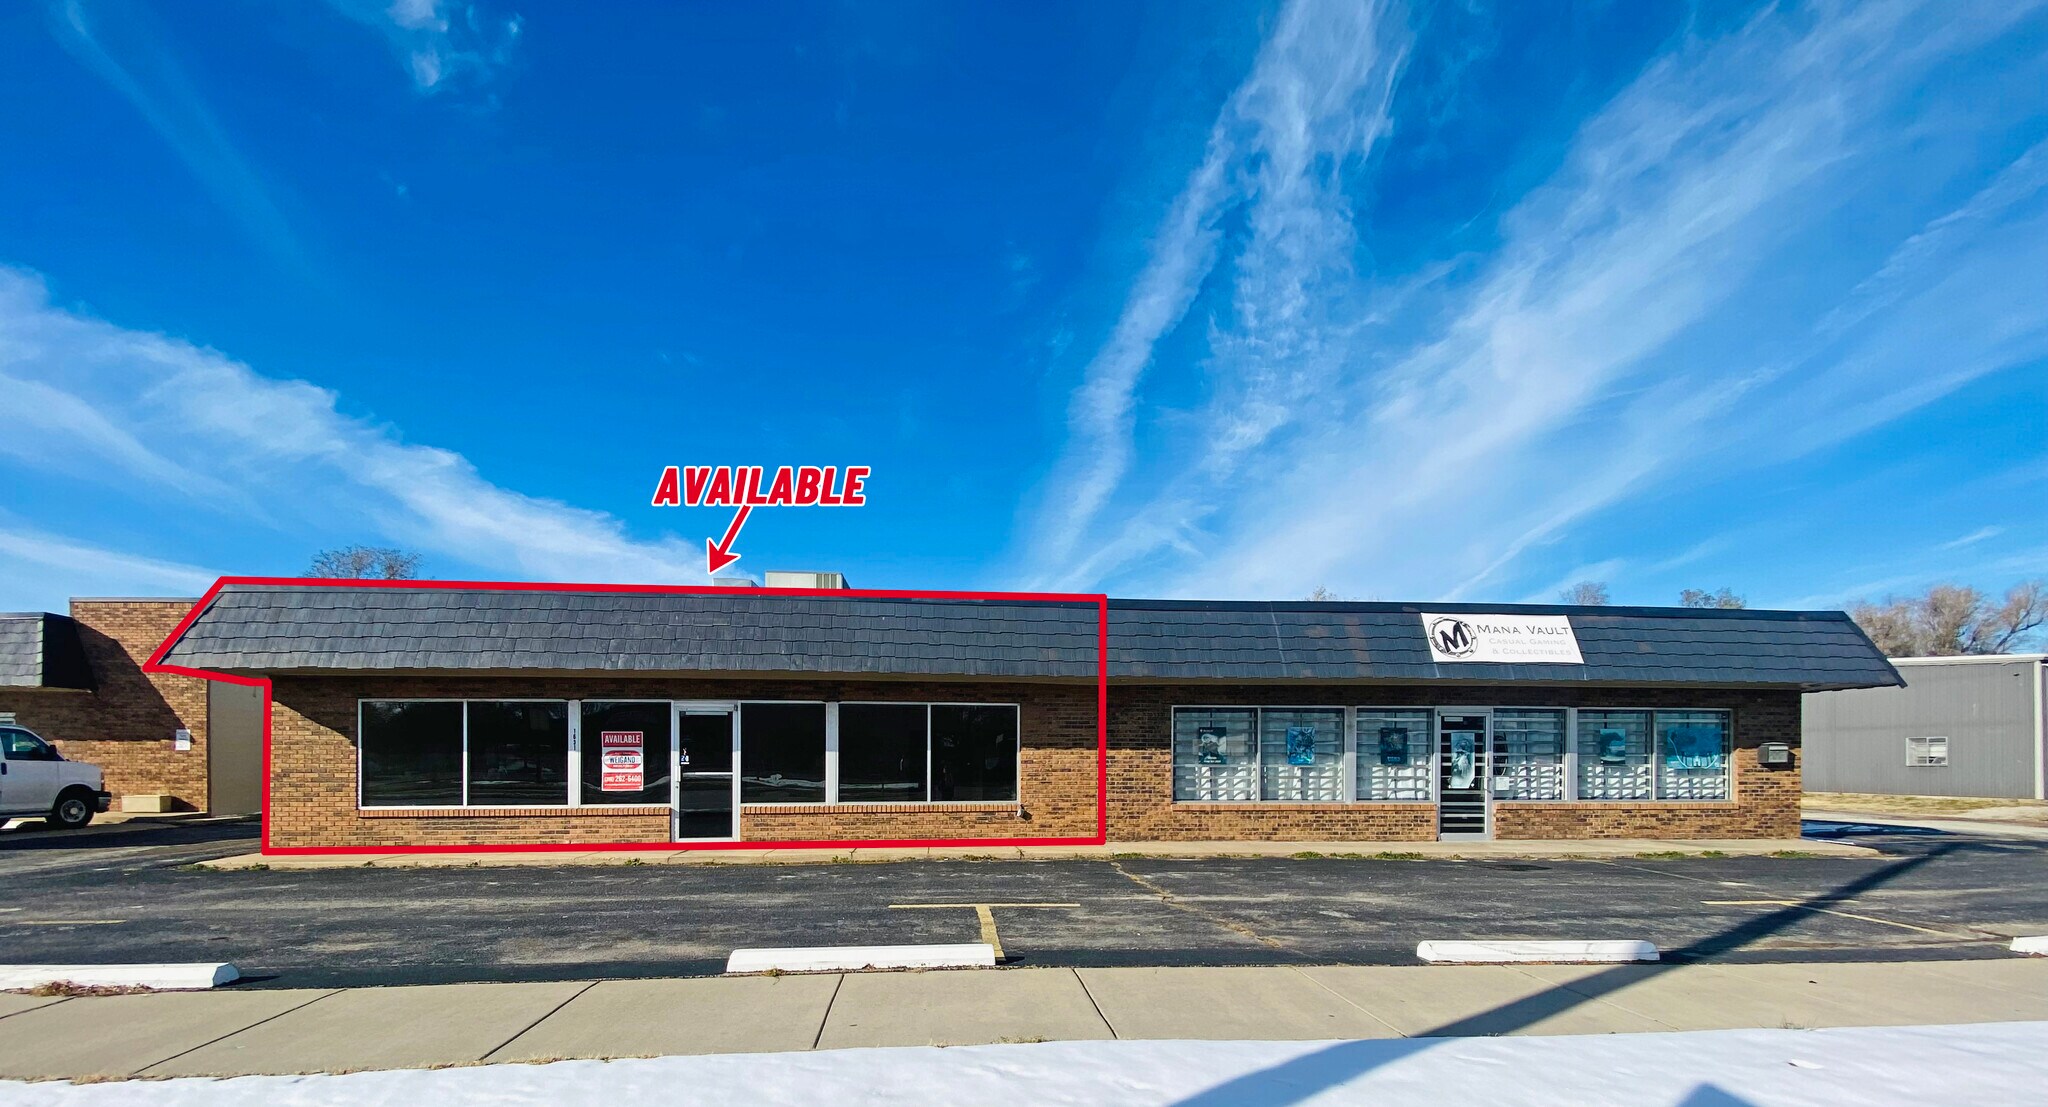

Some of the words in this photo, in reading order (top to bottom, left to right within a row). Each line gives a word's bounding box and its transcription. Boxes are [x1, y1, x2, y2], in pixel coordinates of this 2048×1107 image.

[1476, 624, 1521, 635] MANA
[1526, 625, 1569, 635] VAULT
[1439, 621, 1469, 653] M
[1529, 638, 1567, 646] GAMING
[1502, 648, 1572, 656] COLLECTIBLES
[604, 734, 641, 744] AVAILABLE
[609, 756, 636, 764] WEIGAND
